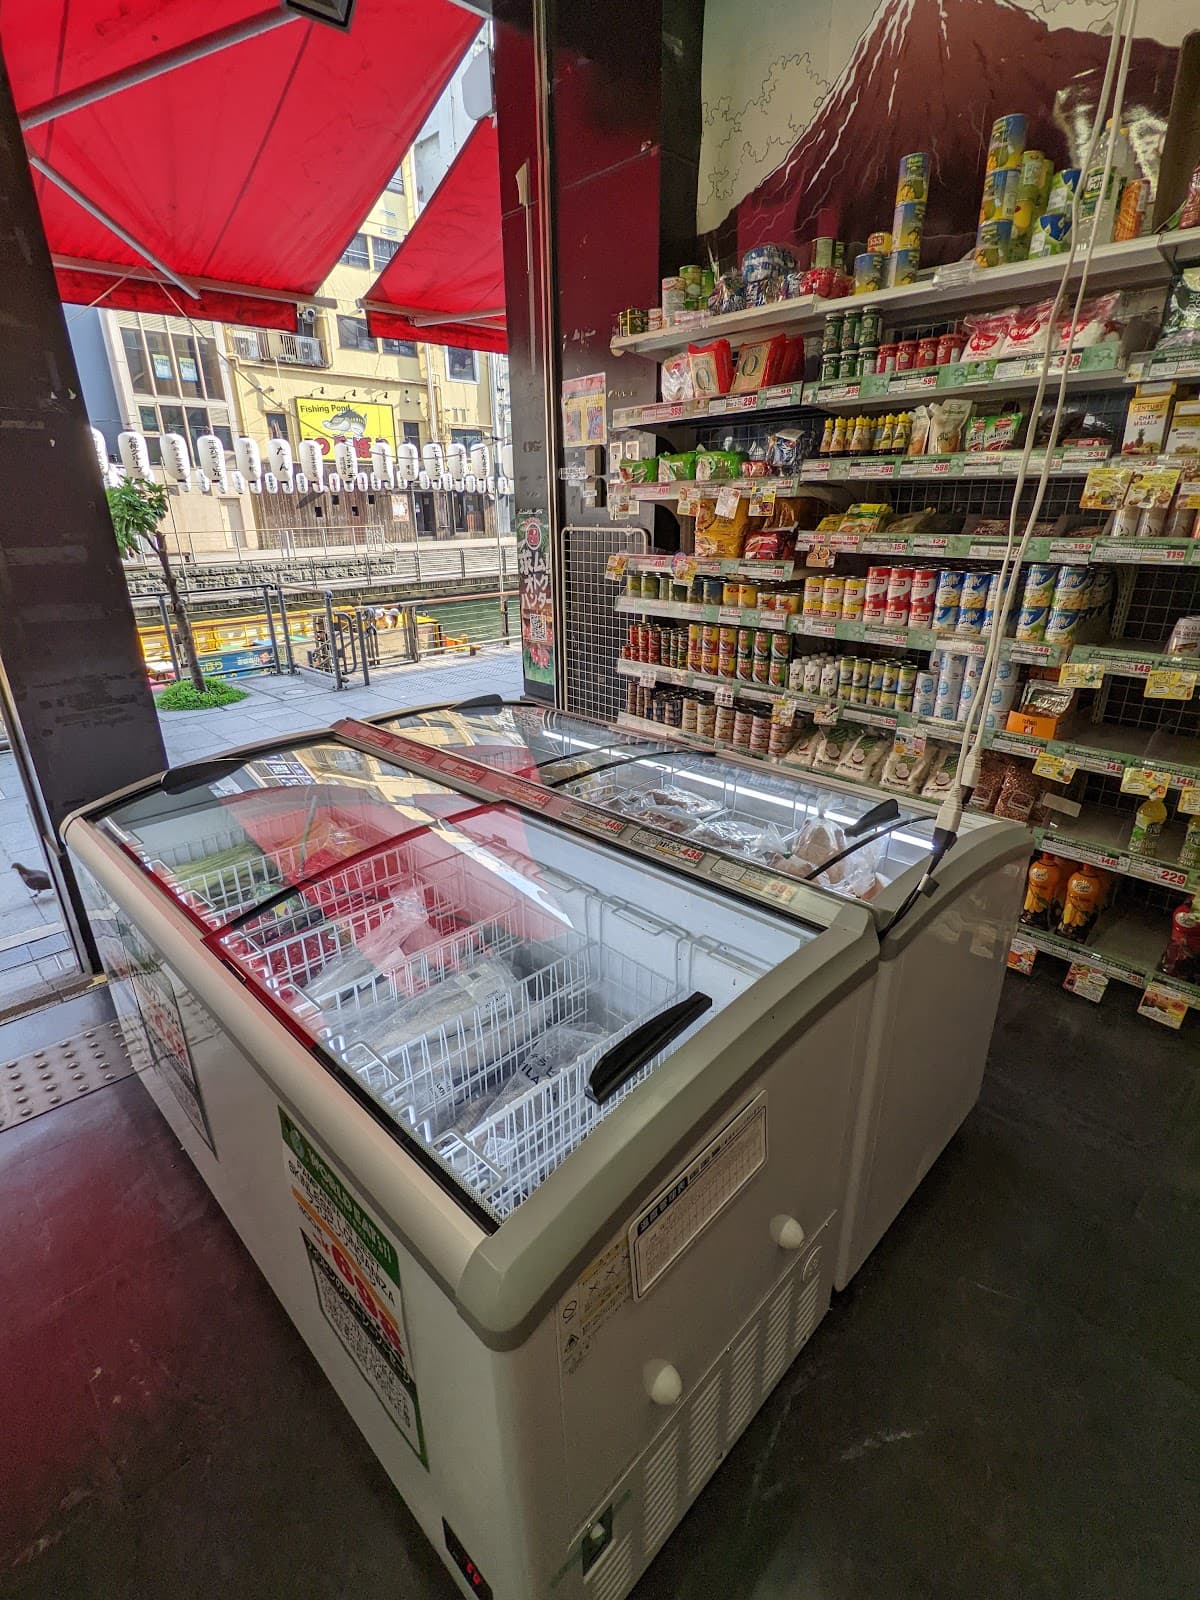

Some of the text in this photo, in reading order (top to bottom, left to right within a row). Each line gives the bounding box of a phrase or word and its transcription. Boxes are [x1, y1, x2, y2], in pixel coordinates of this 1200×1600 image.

[743, 395, 757, 407] 298
[300, 404, 351, 413] Fishing Pond
[1086, 450, 1107, 458] 238
[1073, 543, 1092, 551] 199
[1165, 550, 1184, 559] 119
[525, 573, 549, 594] オトク
[521, 593, 552, 610] ハンター
[1133, 664, 1151, 673] 148
[1105, 761, 1122, 772] 148
[1176, 776, 1194, 786] 148
[680, 846, 703, 862] 438
[1159, 869, 1186, 886] 229
